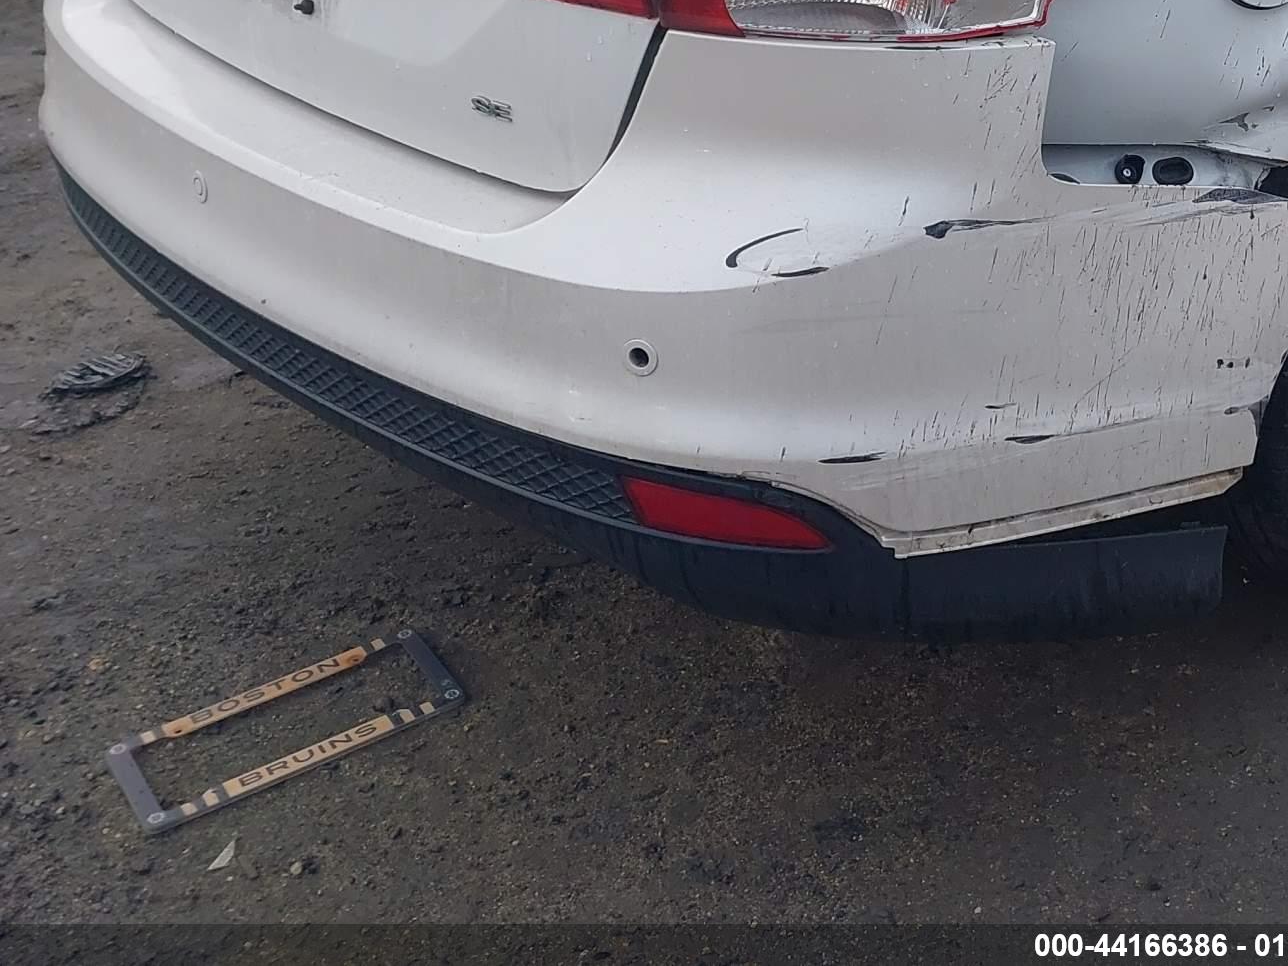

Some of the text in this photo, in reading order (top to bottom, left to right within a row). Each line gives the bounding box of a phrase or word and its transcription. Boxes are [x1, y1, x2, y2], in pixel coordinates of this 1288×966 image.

[470, 95, 513, 123] SE
[188, 657, 342, 724] BOSTON
[238, 723, 378, 788] BRUINS
